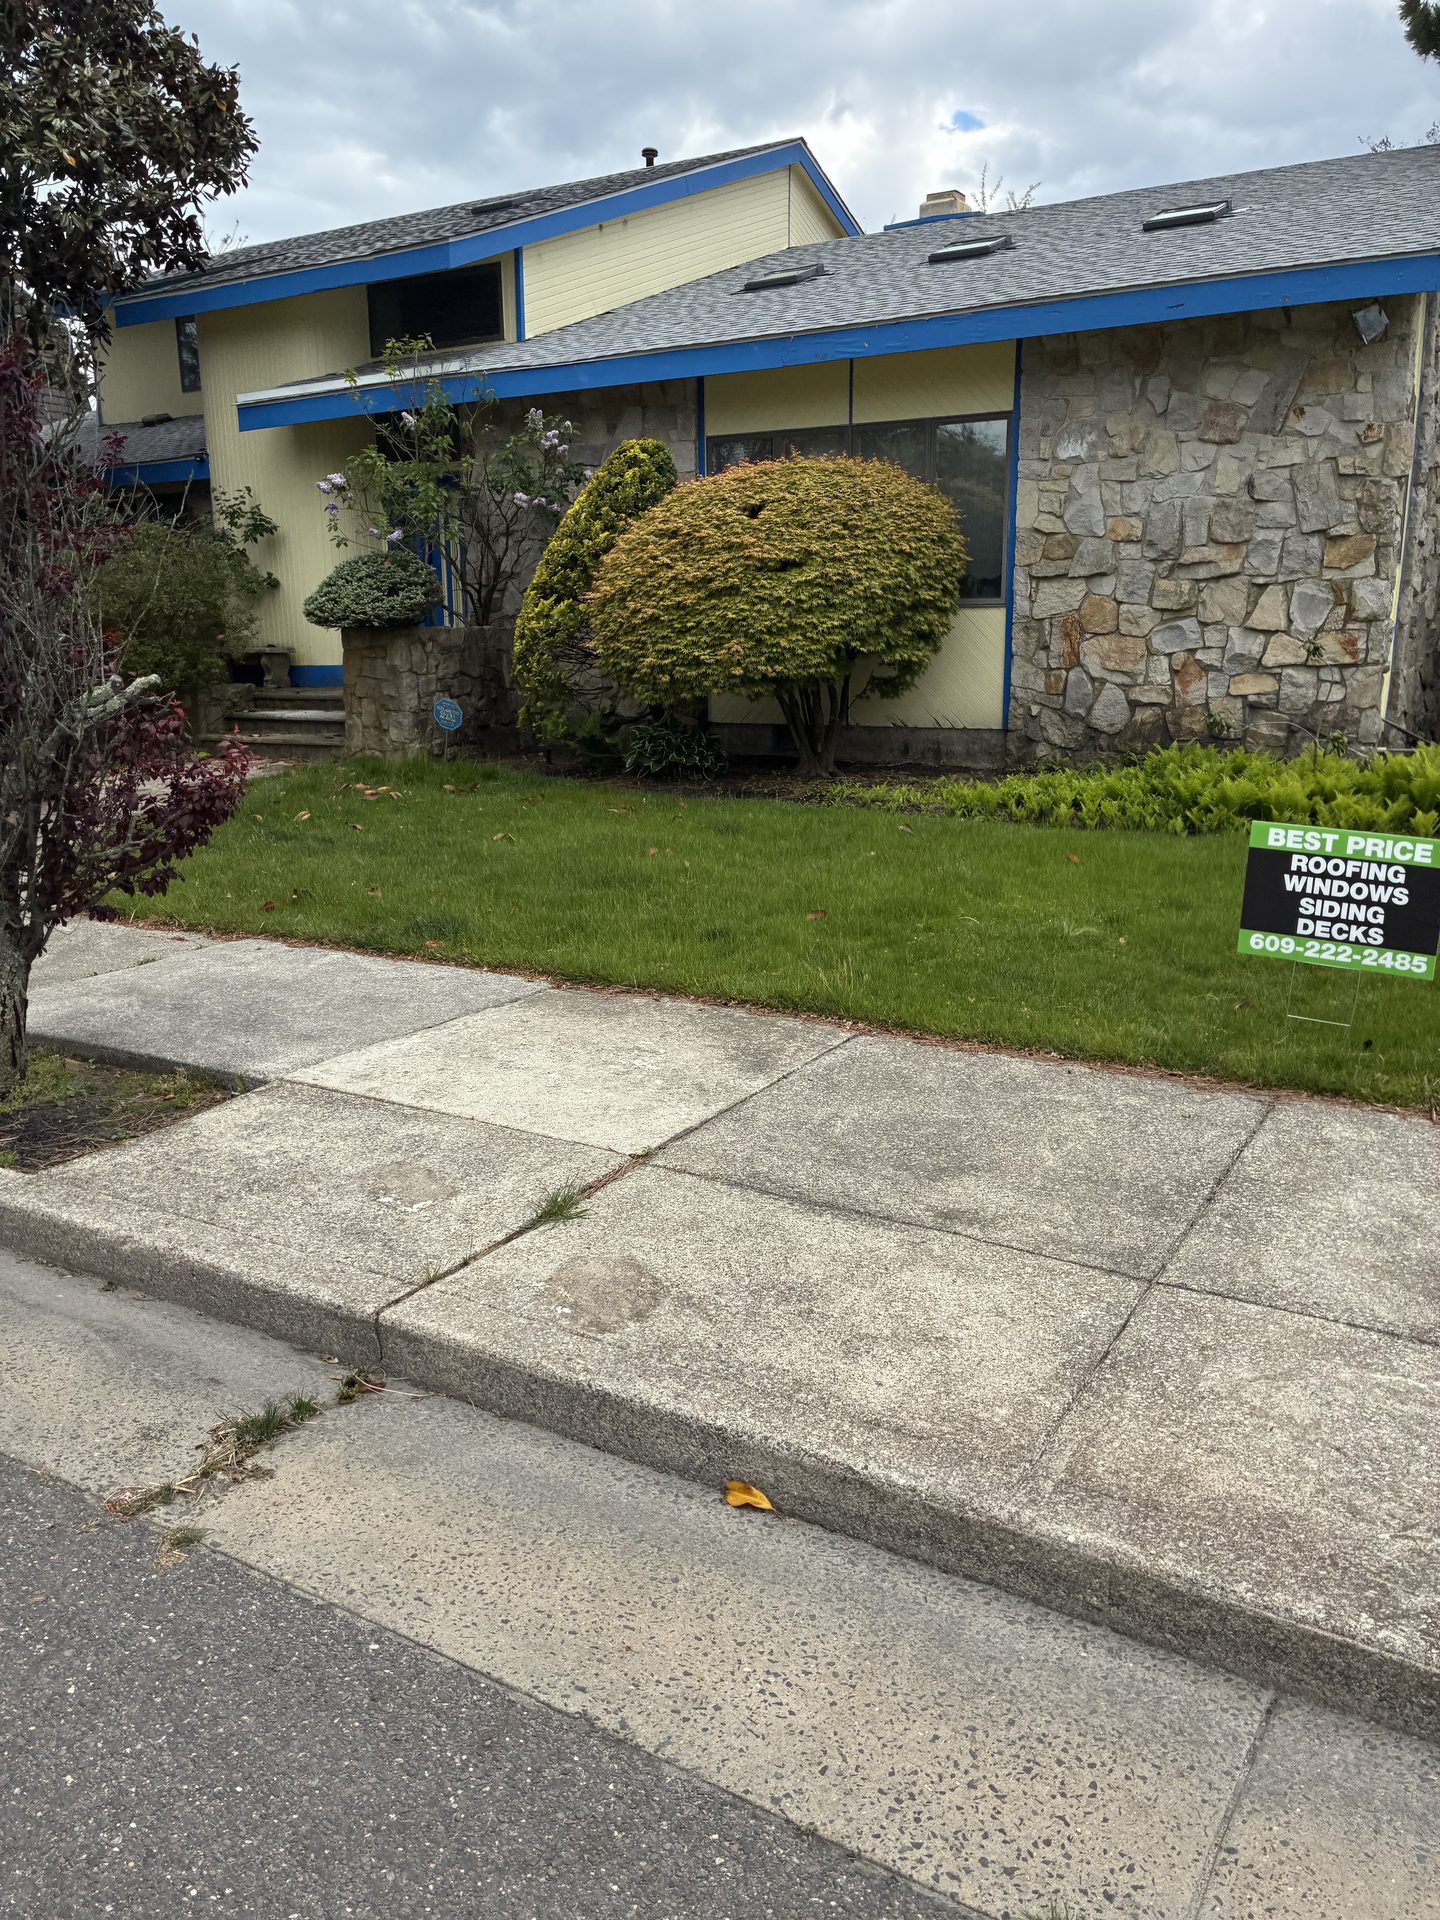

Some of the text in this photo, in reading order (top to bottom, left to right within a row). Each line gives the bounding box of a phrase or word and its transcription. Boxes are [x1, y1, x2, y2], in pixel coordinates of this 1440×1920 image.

[1267, 828, 1434, 864] BEST PRICE
[1291, 854, 1406, 884] ROOFING
[1283, 874, 1409, 905] WINDOWS
[1298, 897, 1385, 924] SIDING
[1296, 918, 1384, 945] DECKS
[1249, 933, 1428, 973] 609-222-2485
